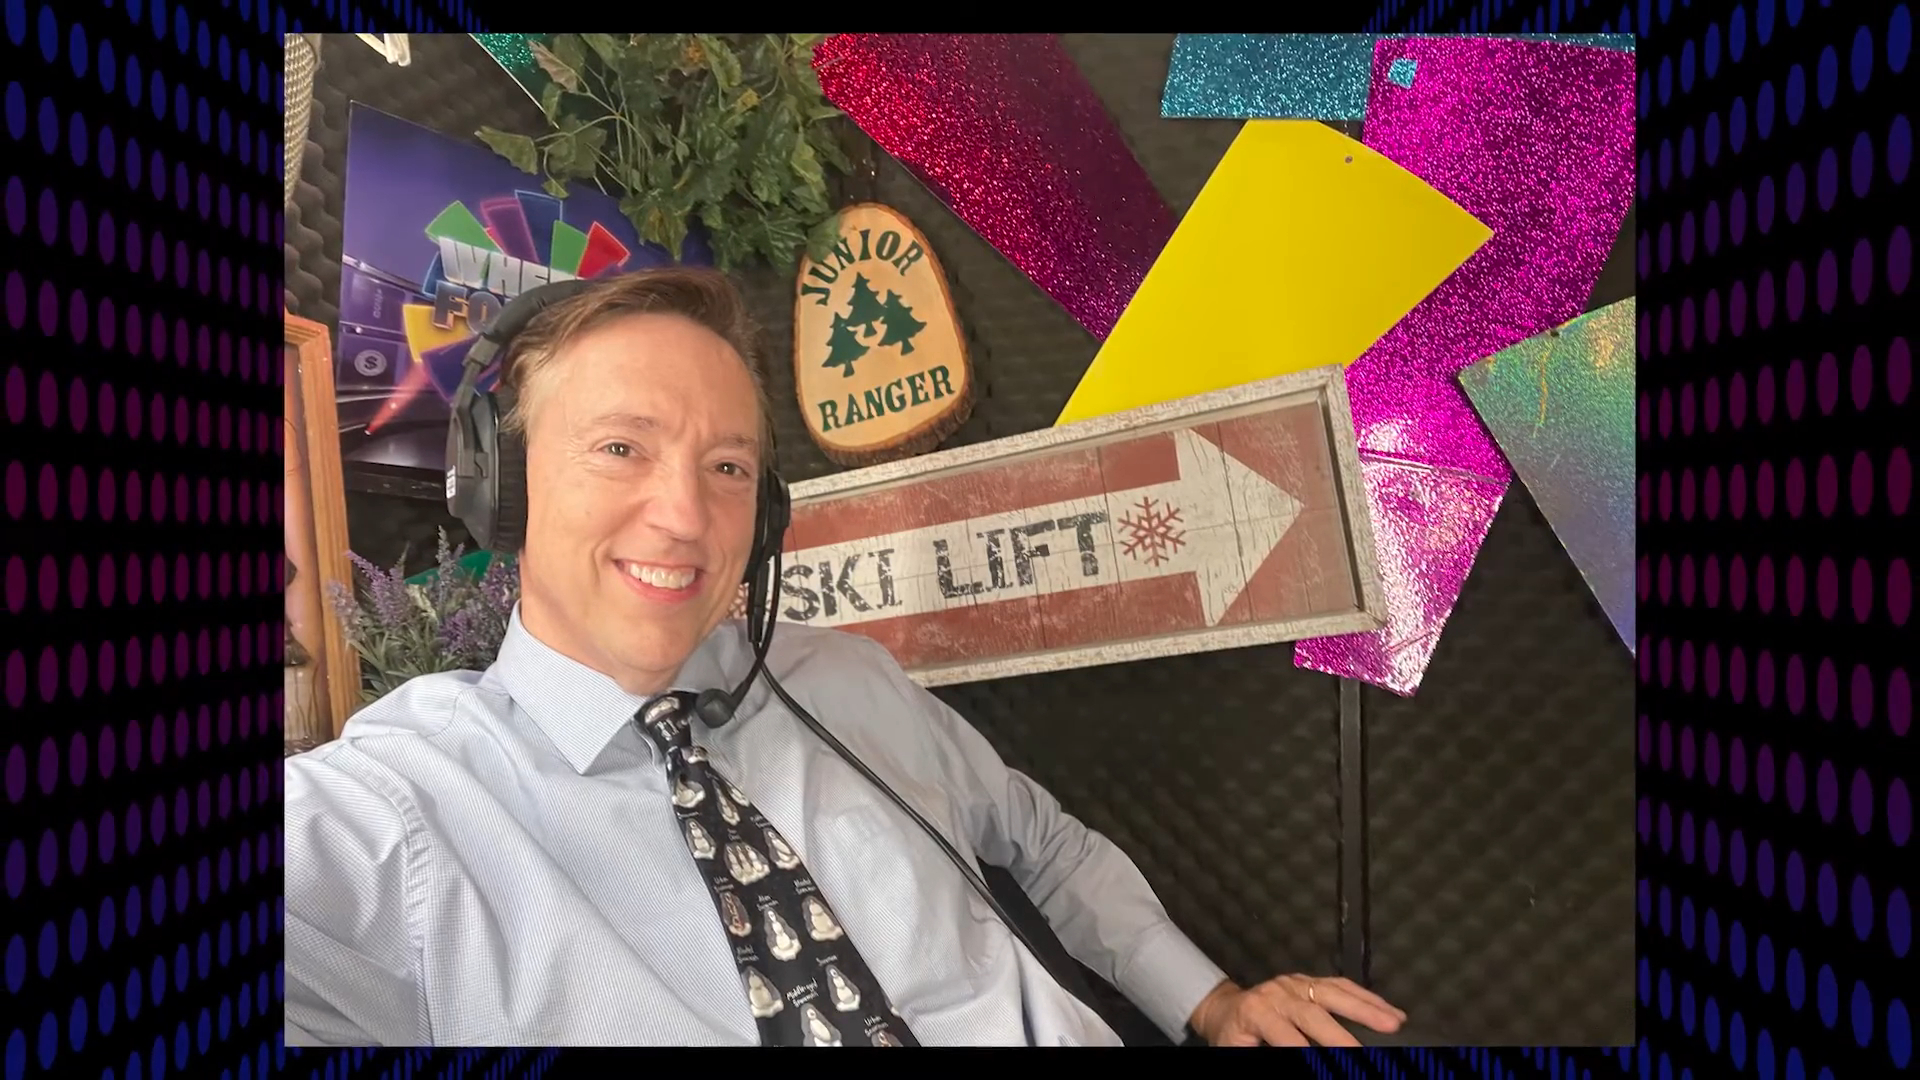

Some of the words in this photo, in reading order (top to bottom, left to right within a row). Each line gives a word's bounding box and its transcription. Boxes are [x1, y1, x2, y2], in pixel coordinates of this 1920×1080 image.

[438, 236, 578, 298] WHE
[801, 228, 925, 307] JUNIOR
[817, 365, 956, 433] RANGER
[780, 547, 904, 622] SKI
[931, 509, 1108, 600] LIFT
